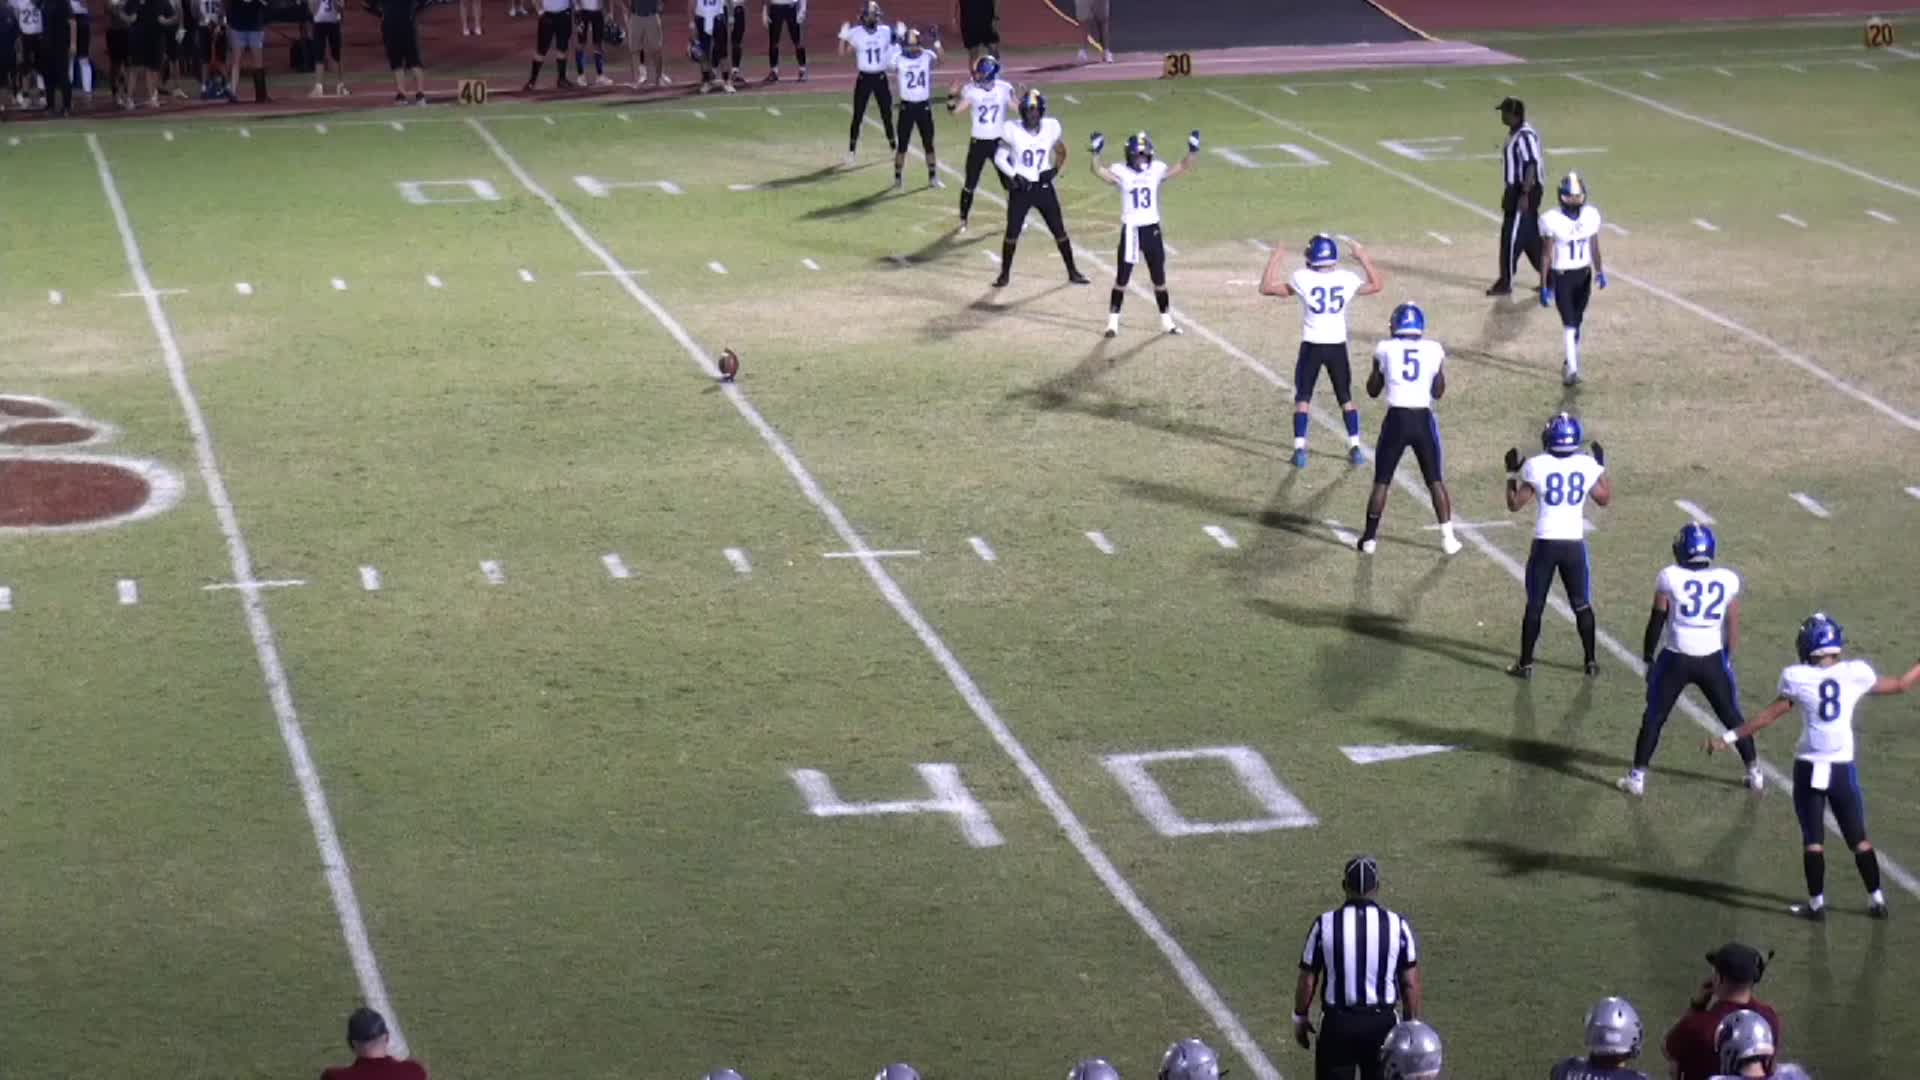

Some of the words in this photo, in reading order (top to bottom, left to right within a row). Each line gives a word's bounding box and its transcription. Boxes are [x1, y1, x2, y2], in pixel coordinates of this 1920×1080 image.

[1869, 23, 1893, 47] 20
[866, 47, 881, 64] 11
[1167, 53, 1191, 77] 30
[906, 69, 927, 89] 24
[460, 80, 486, 105] 40
[978, 104, 1000, 124] 27
[1129, 187, 1152, 209] 13
[1310, 286, 1345, 314] 35
[1402, 349, 1420, 382] 5
[1544, 472, 1585, 506] 88
[1680, 579, 1724, 620] 32
[1818, 678, 1841, 722] 8
